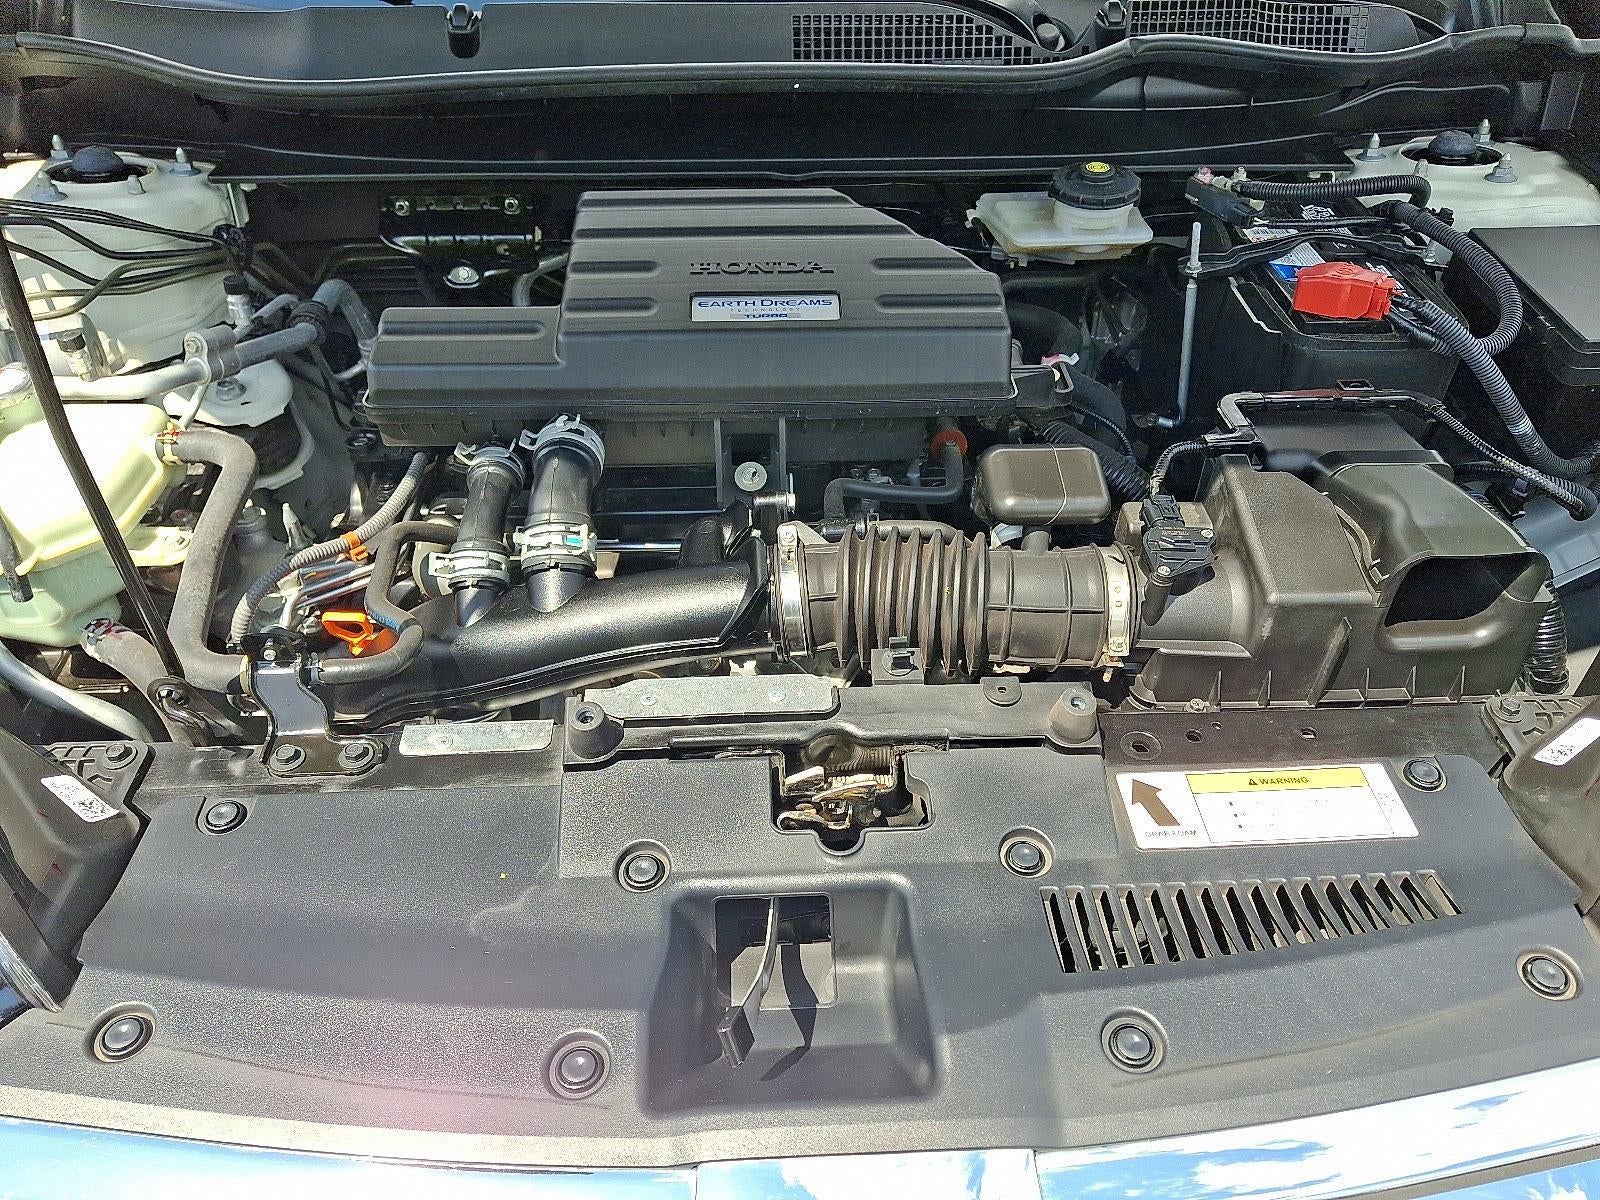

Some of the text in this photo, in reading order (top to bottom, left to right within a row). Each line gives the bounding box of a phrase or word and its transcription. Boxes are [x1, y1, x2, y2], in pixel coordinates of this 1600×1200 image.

[690, 261, 835, 275] HONDA
[697, 299, 833, 308] EARTH DREAMS
[1258, 776, 1309, 786] WARNING
